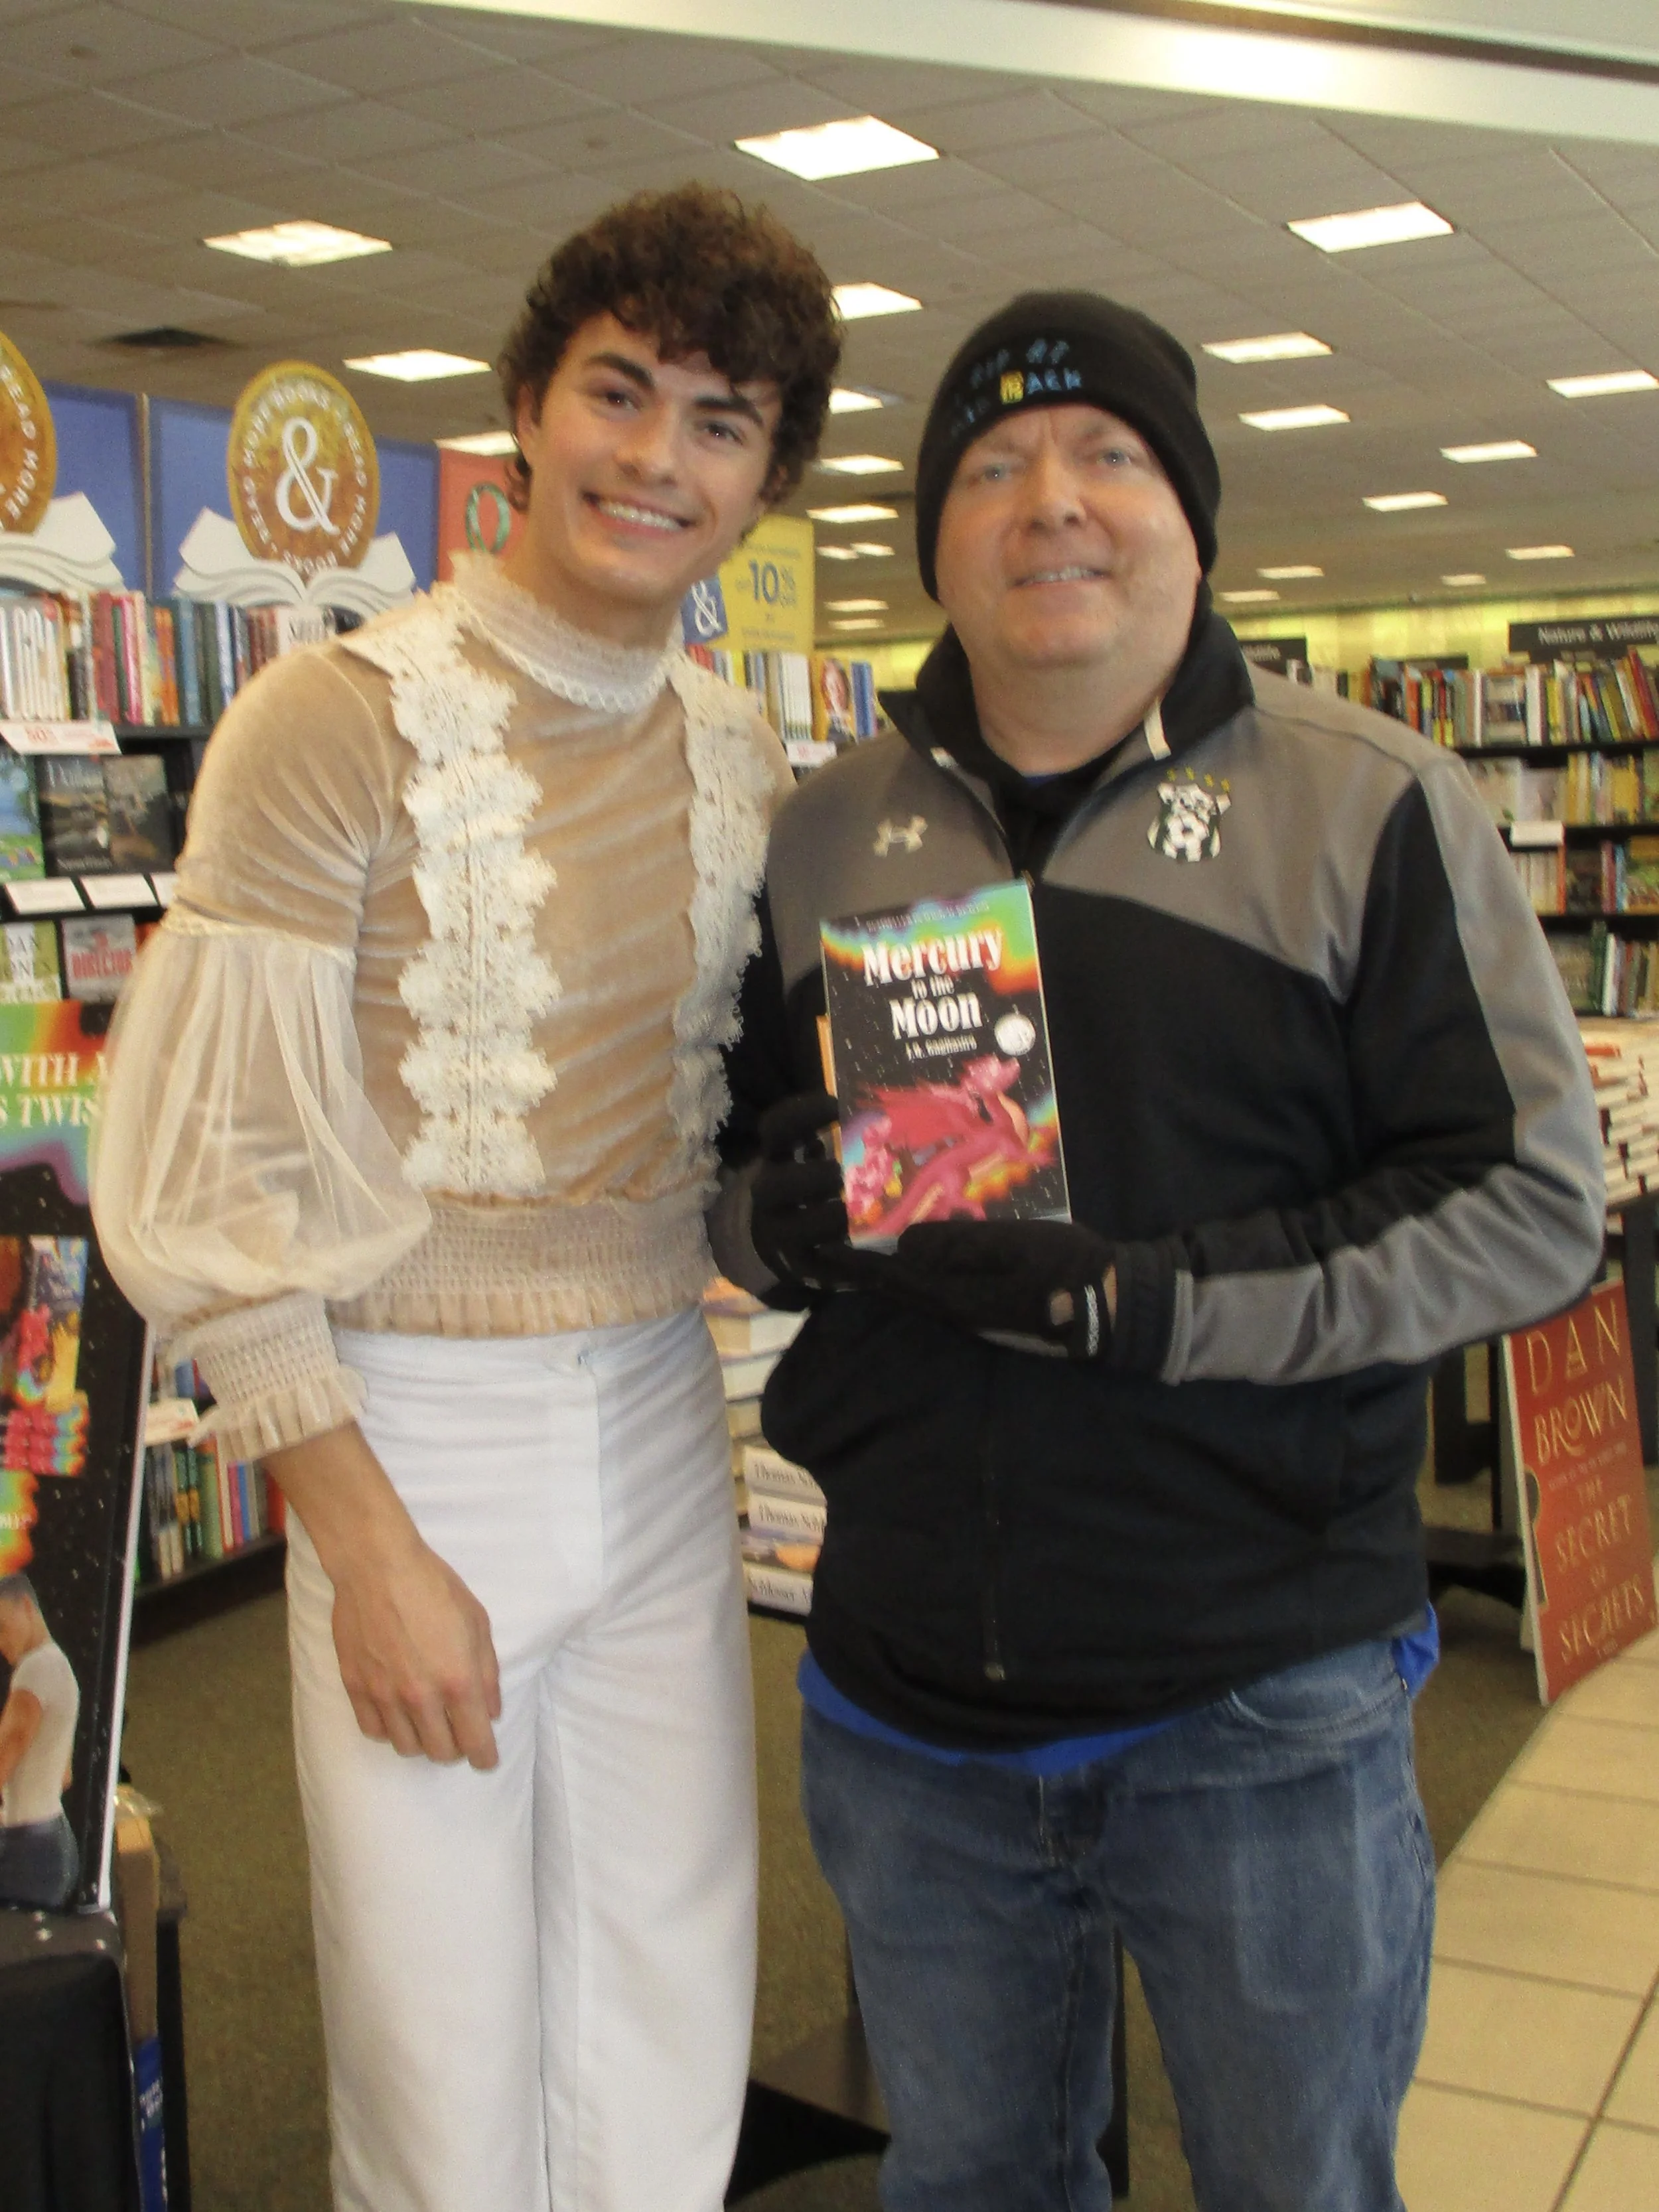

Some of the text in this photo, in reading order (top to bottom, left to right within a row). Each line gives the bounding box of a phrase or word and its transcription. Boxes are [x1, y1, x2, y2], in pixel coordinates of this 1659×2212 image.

[274, 415, 340, 535] &
[861, 926, 1005, 987] Mercury
[911, 973, 955, 1001] to the
[889, 991, 983, 1040] Moon
[1526, 1297, 1621, 1397] DAN
[1534, 1373, 1628, 1467] BROWN
